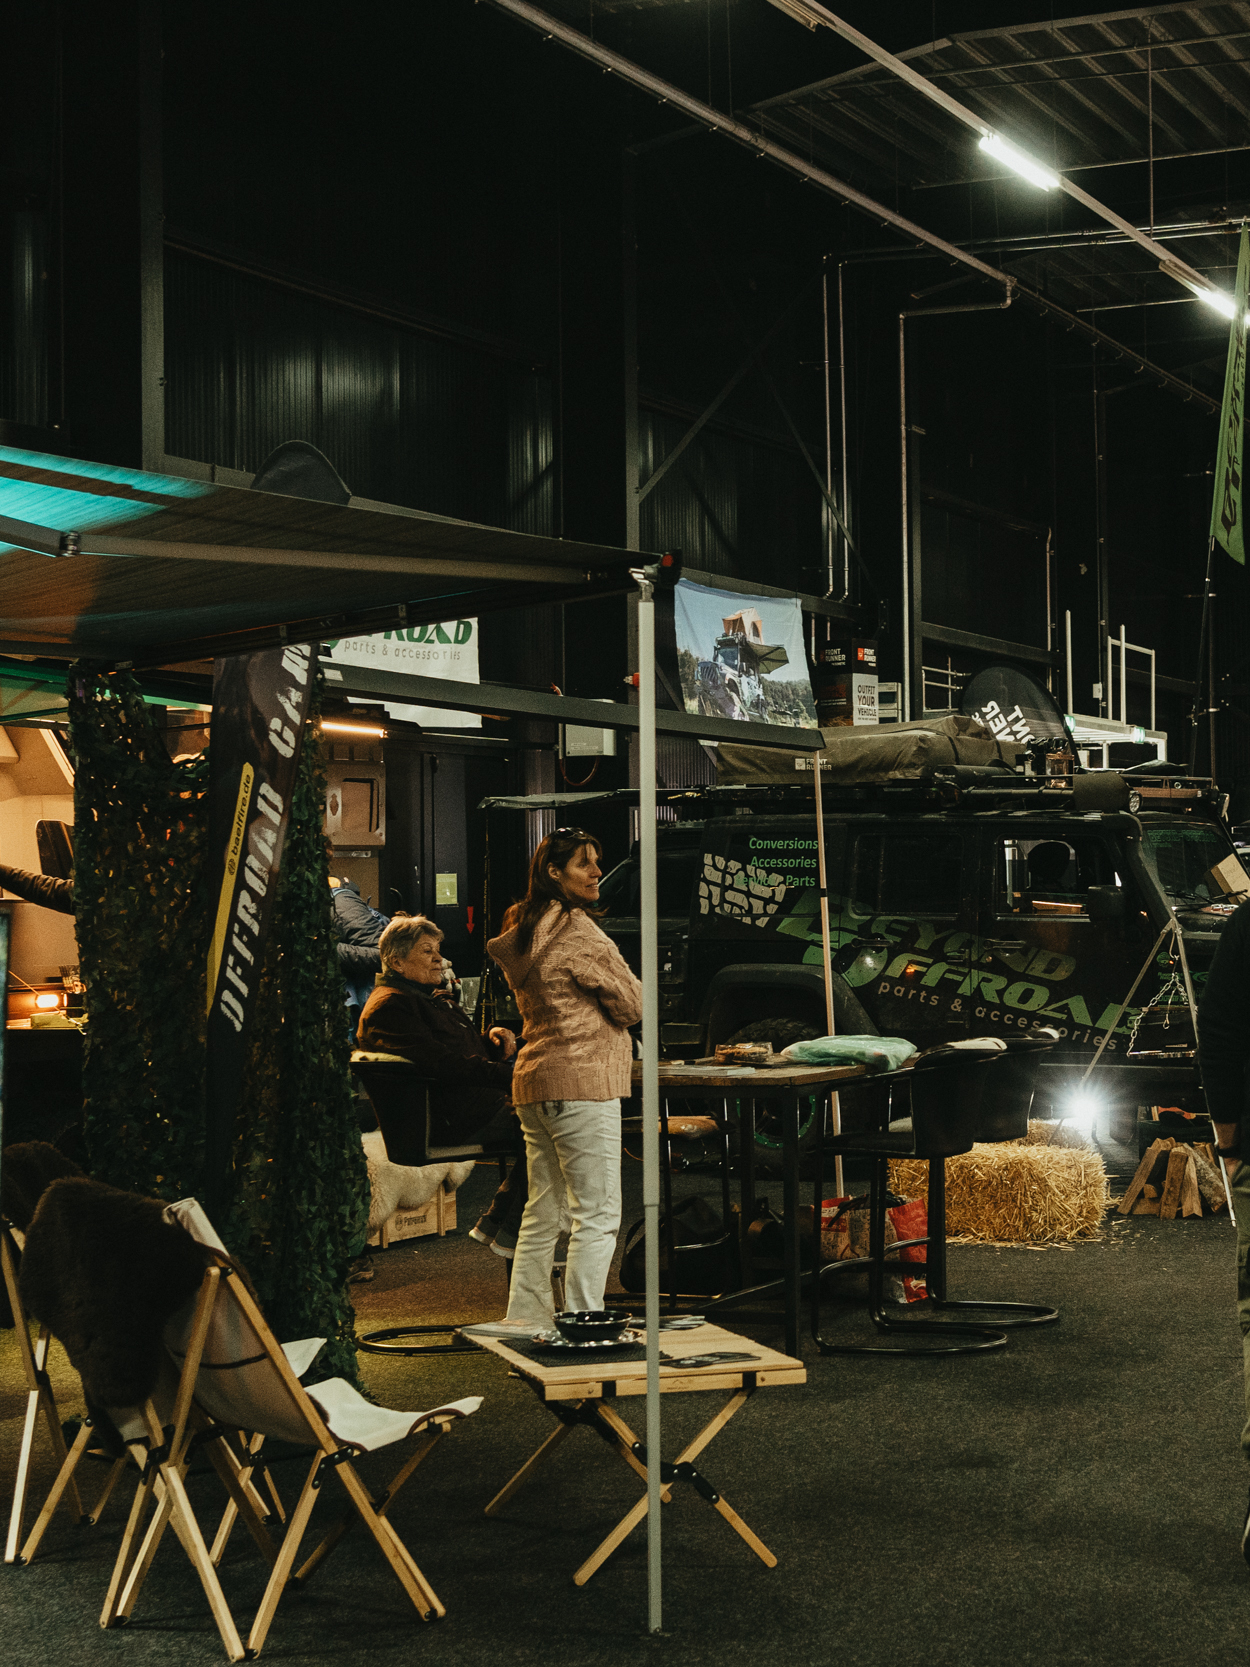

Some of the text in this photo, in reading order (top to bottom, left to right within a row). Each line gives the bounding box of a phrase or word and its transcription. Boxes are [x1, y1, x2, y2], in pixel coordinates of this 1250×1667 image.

[344, 639, 461, 660] parts & accessories
[857, 684, 876, 695] OUTFIT
[857, 695, 875, 707] YOUR
[858, 707, 877, 717] VEHICLE
[232, 773, 251, 857] baelfire.de
[749, 837, 819, 850] Conversions
[750, 856, 817, 868] Accessories
[786, 875, 816, 887] Parts
[220, 782, 284, 1032] OFFROAD
[878, 981, 939, 1007] parts
[951, 997, 963, 1012] &
